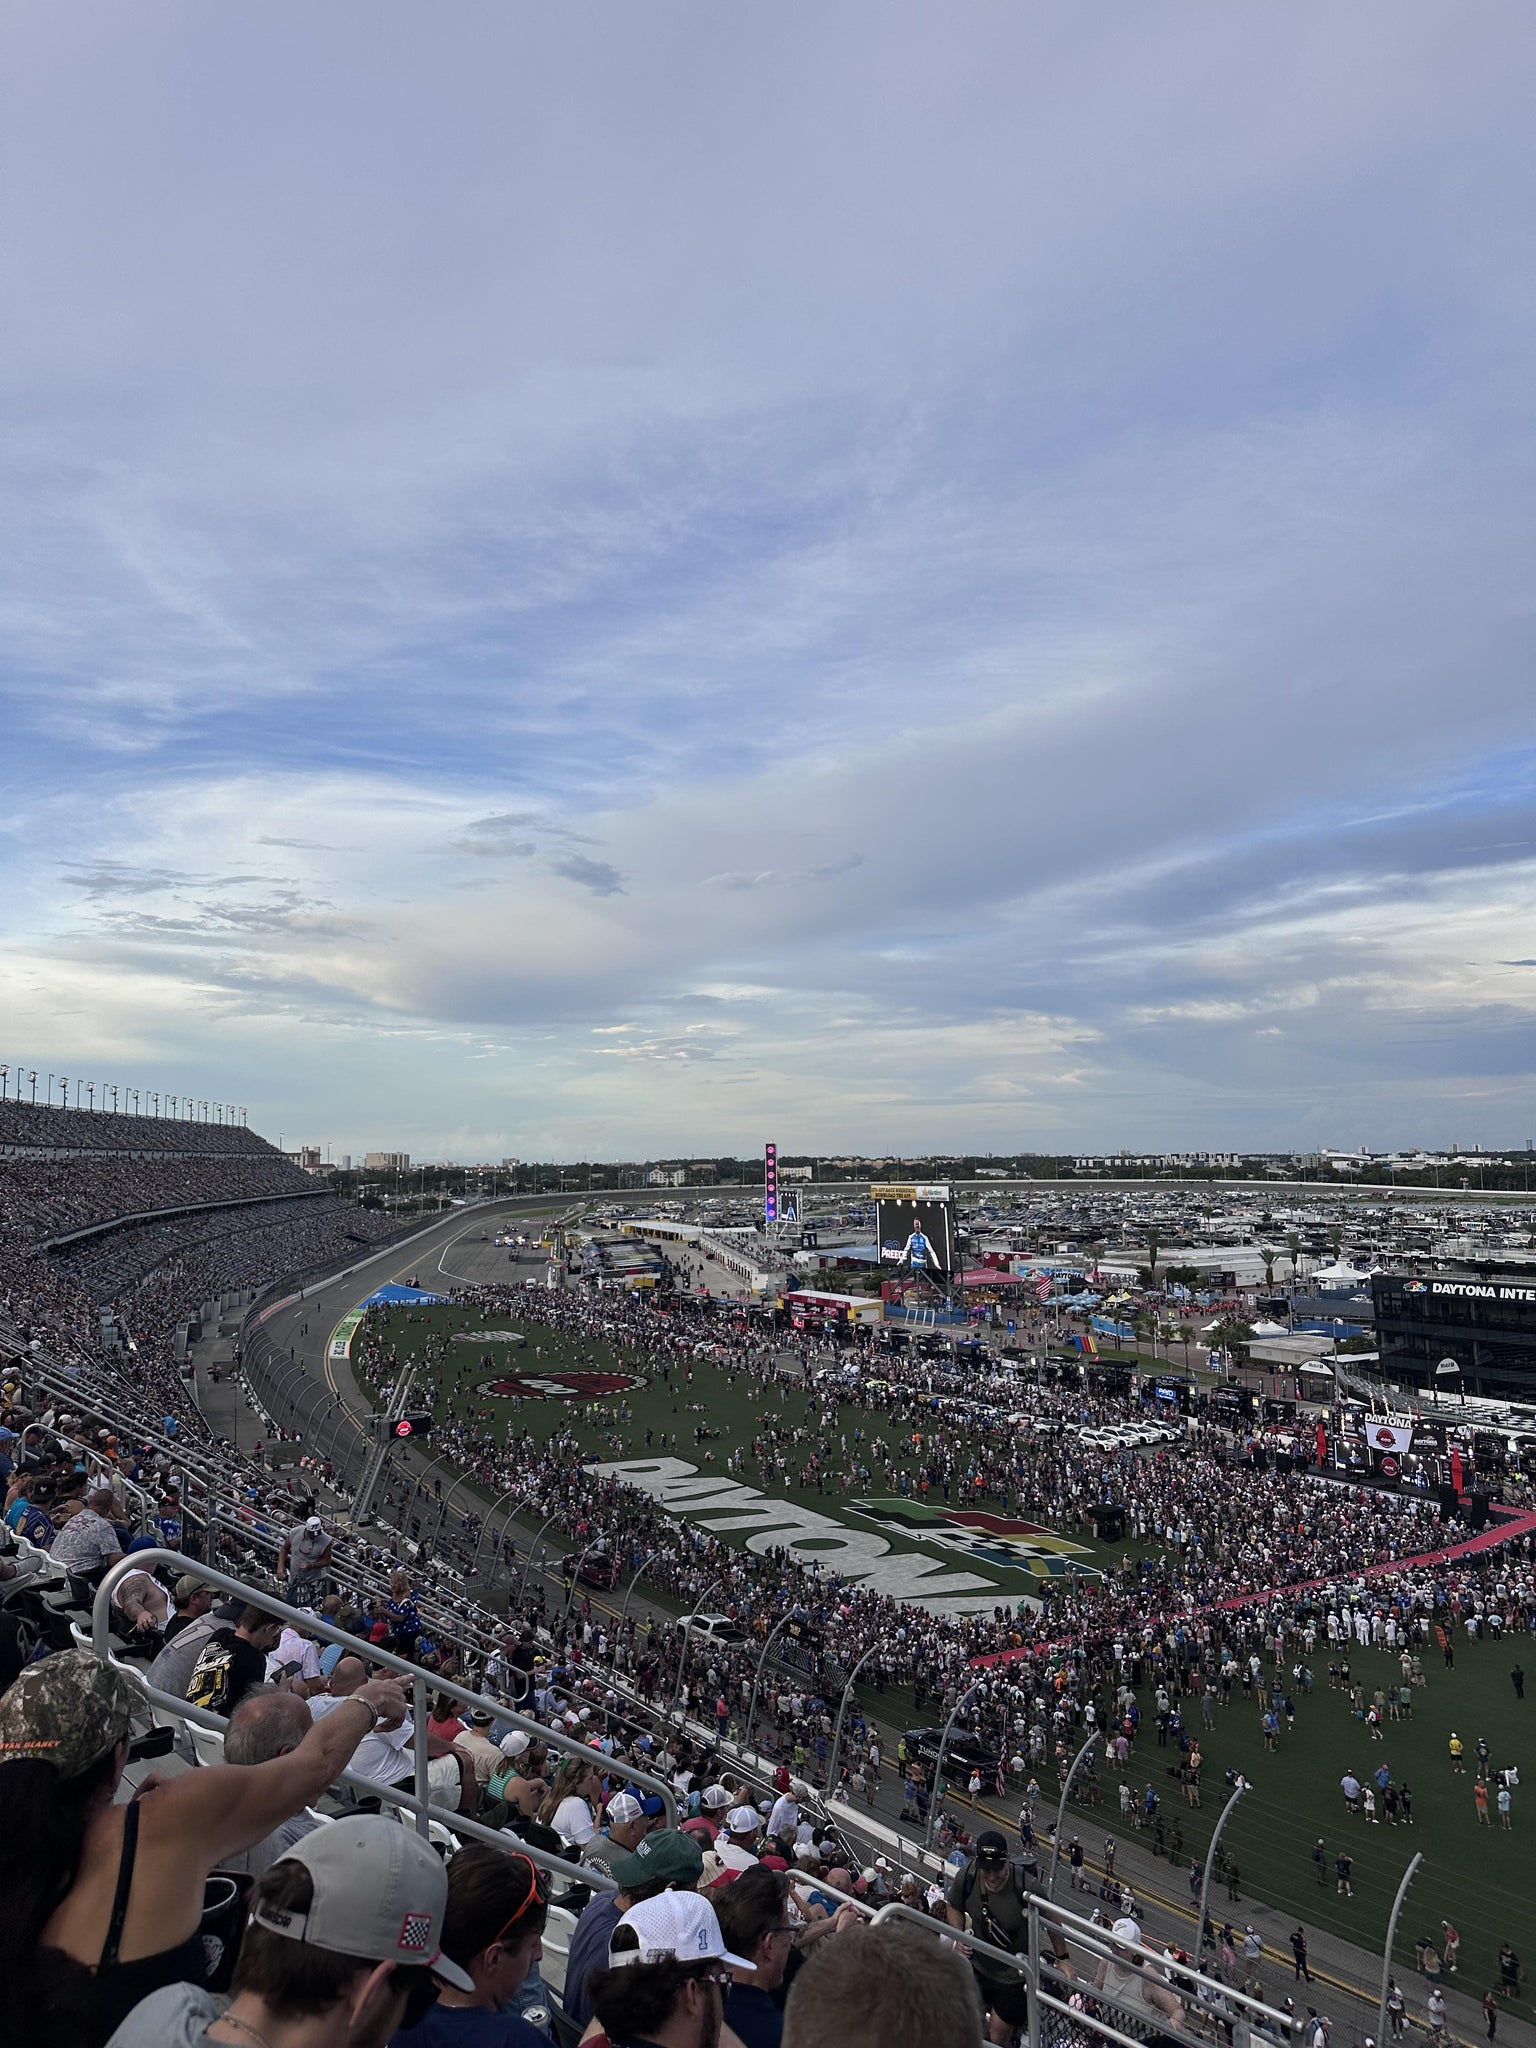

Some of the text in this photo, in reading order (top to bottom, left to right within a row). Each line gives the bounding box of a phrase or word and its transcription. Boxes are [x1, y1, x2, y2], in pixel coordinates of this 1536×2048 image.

[881, 1249, 908, 1260] PREECE
[1432, 1282, 1536, 1302] DAYTONA INTE
[1440, 1361, 1451, 1369] Mobil
[1364, 1412, 1412, 1430] DAYTONA
[918, 1743, 949, 1763] TUNDA
[698, 1928, 708, 1951] 1
